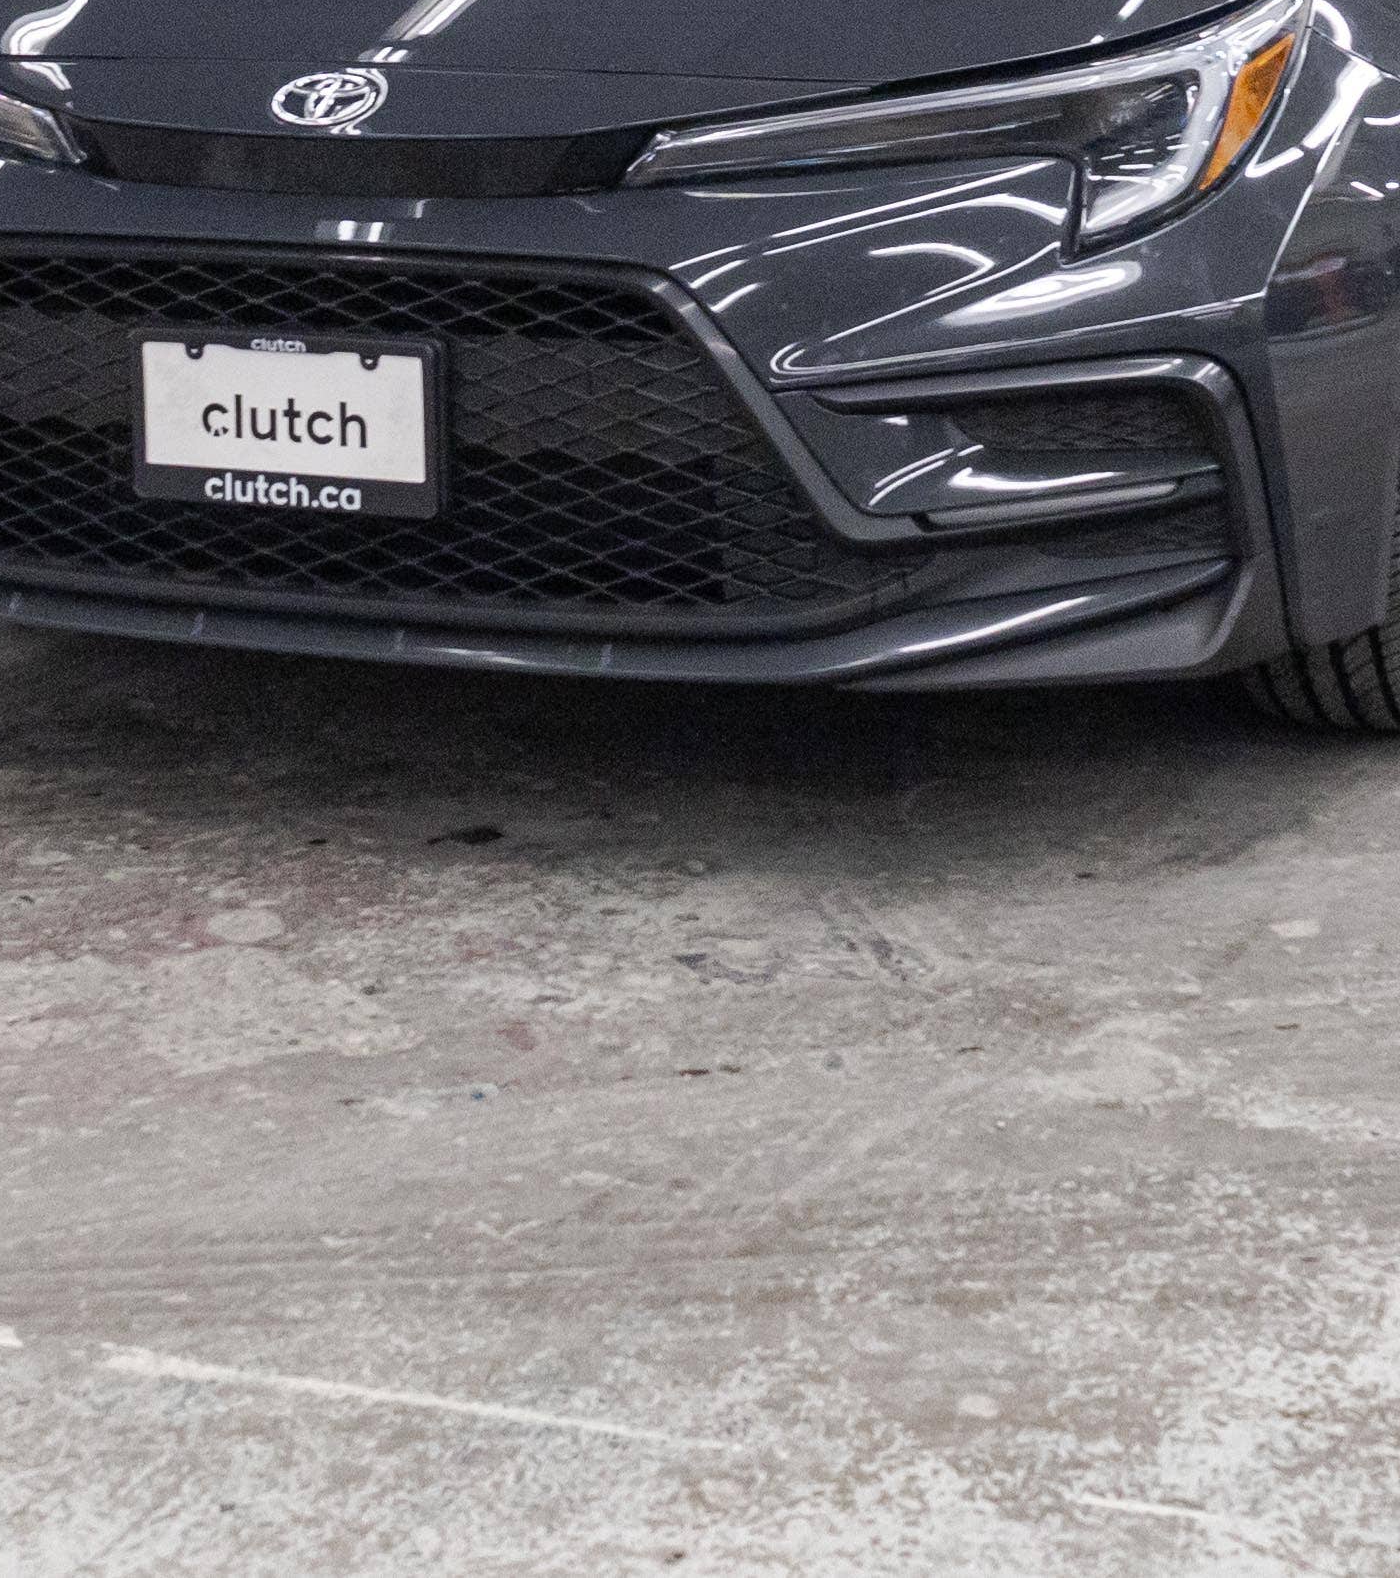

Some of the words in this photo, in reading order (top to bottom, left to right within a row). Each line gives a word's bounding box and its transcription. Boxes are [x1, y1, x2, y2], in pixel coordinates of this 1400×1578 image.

[251, 338, 306, 353] clutch
[202, 394, 367, 448] clutch
[205, 472, 362, 511] clutch.ca
